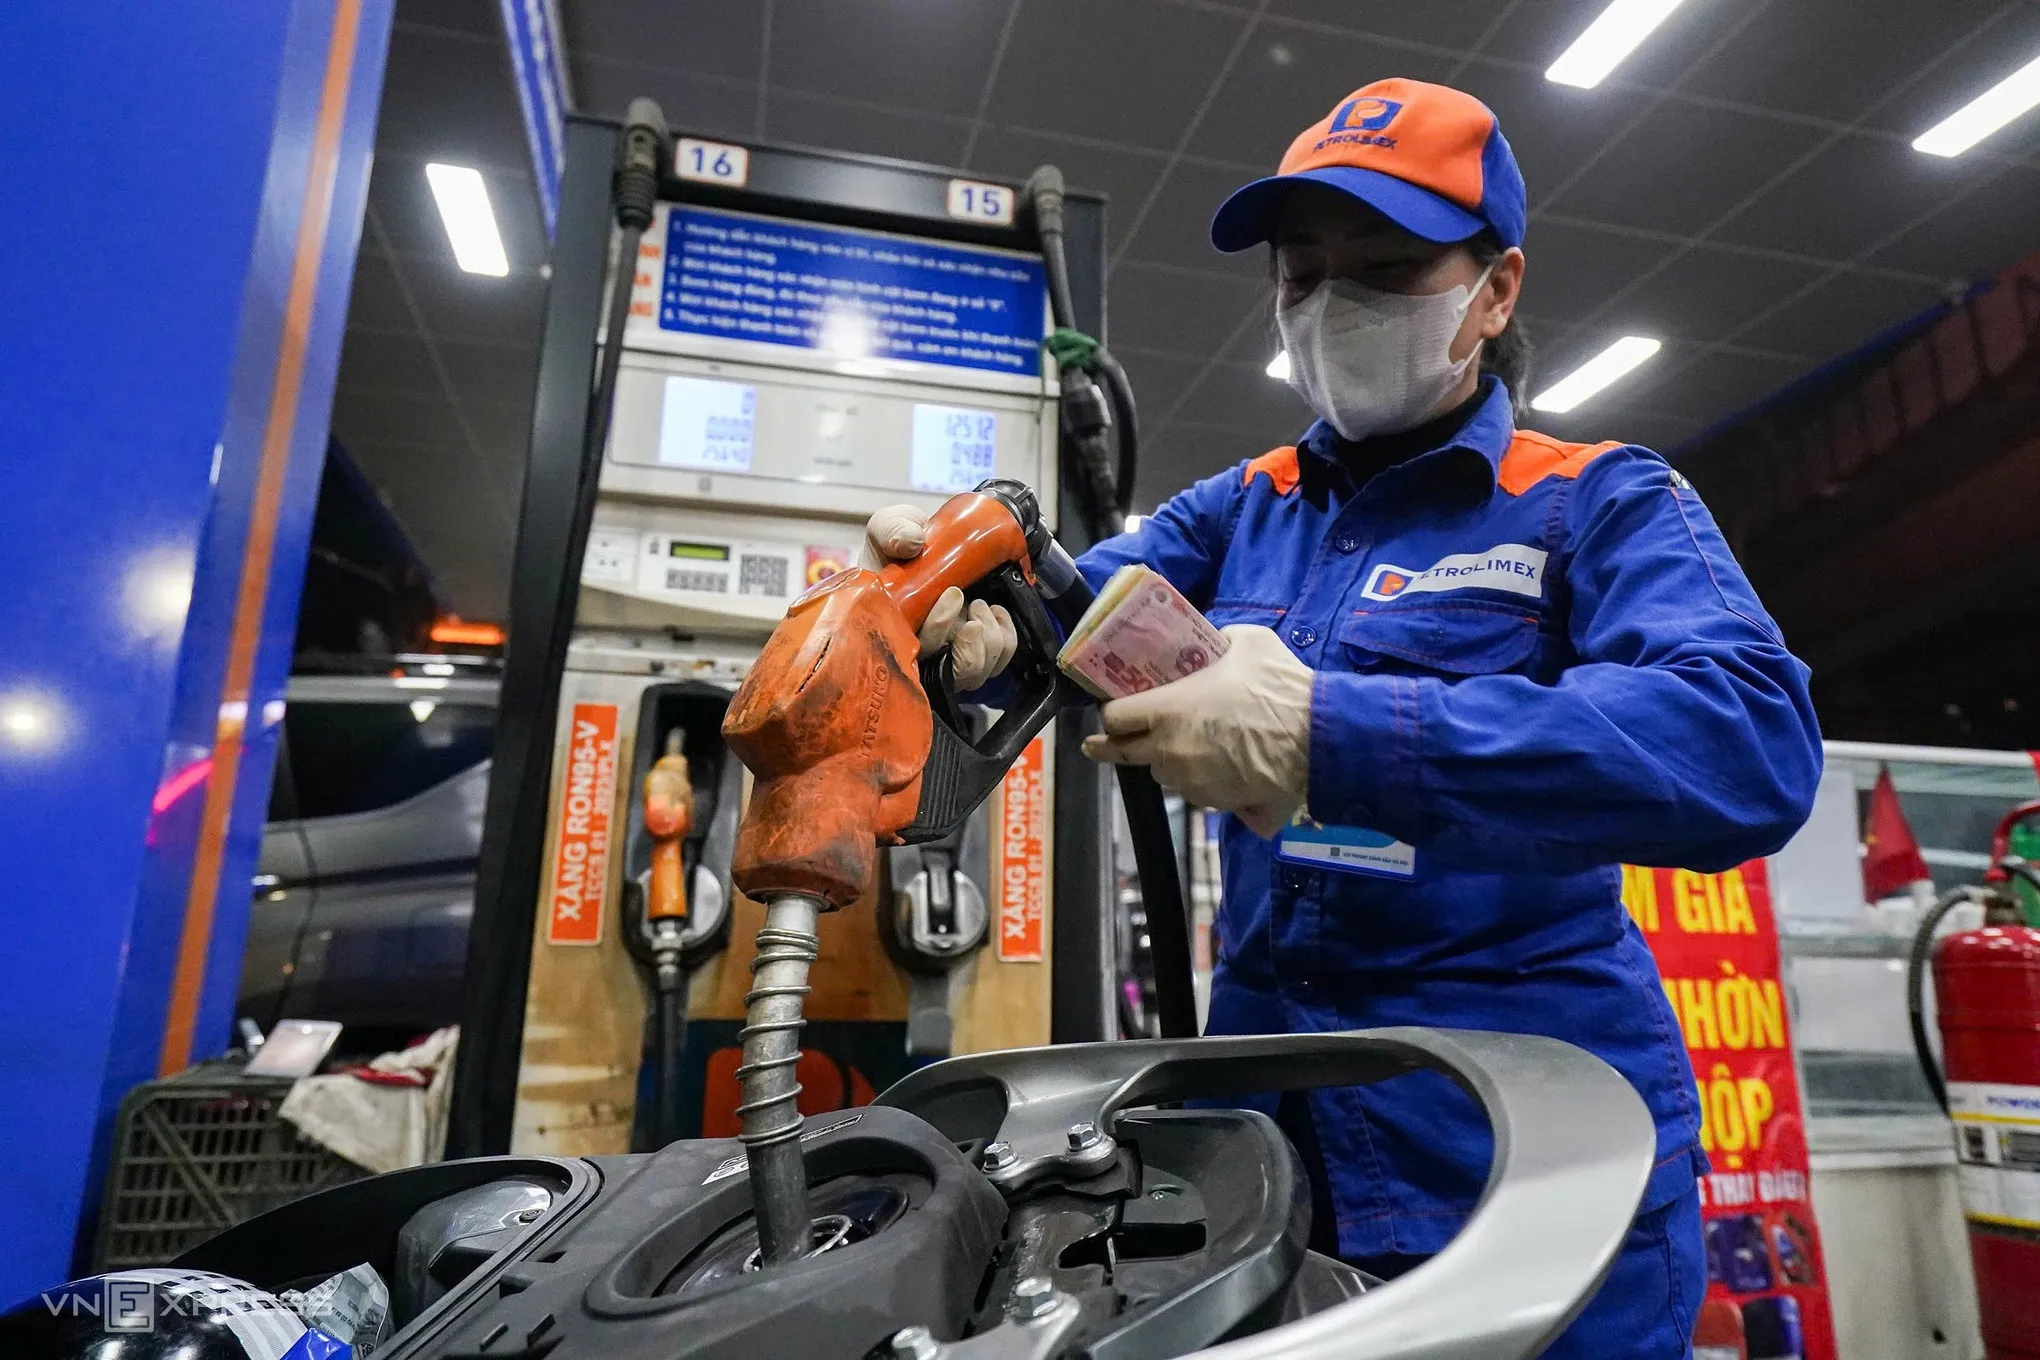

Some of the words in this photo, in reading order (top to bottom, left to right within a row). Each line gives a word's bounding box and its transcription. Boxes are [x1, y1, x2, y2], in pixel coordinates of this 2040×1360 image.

[691, 147, 732, 177] 16
[960, 187, 1000, 216] 15
[569, 720, 601, 836] RON95-V
